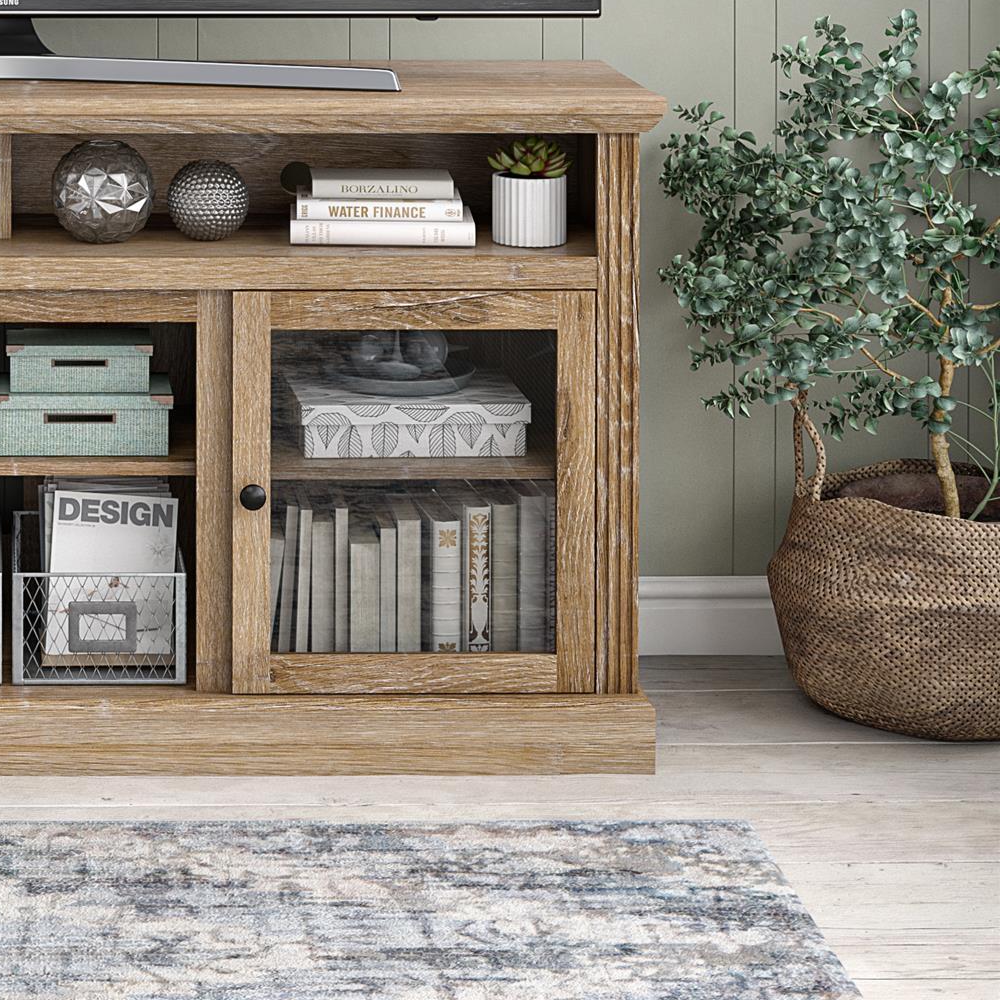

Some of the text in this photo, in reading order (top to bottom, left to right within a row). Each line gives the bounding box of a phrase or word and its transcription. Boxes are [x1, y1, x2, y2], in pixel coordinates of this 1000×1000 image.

[341, 184, 419, 194] BORZALINO
[328, 205, 426, 219] WATER FINANCE
[58, 497, 174, 528] DESIGN
